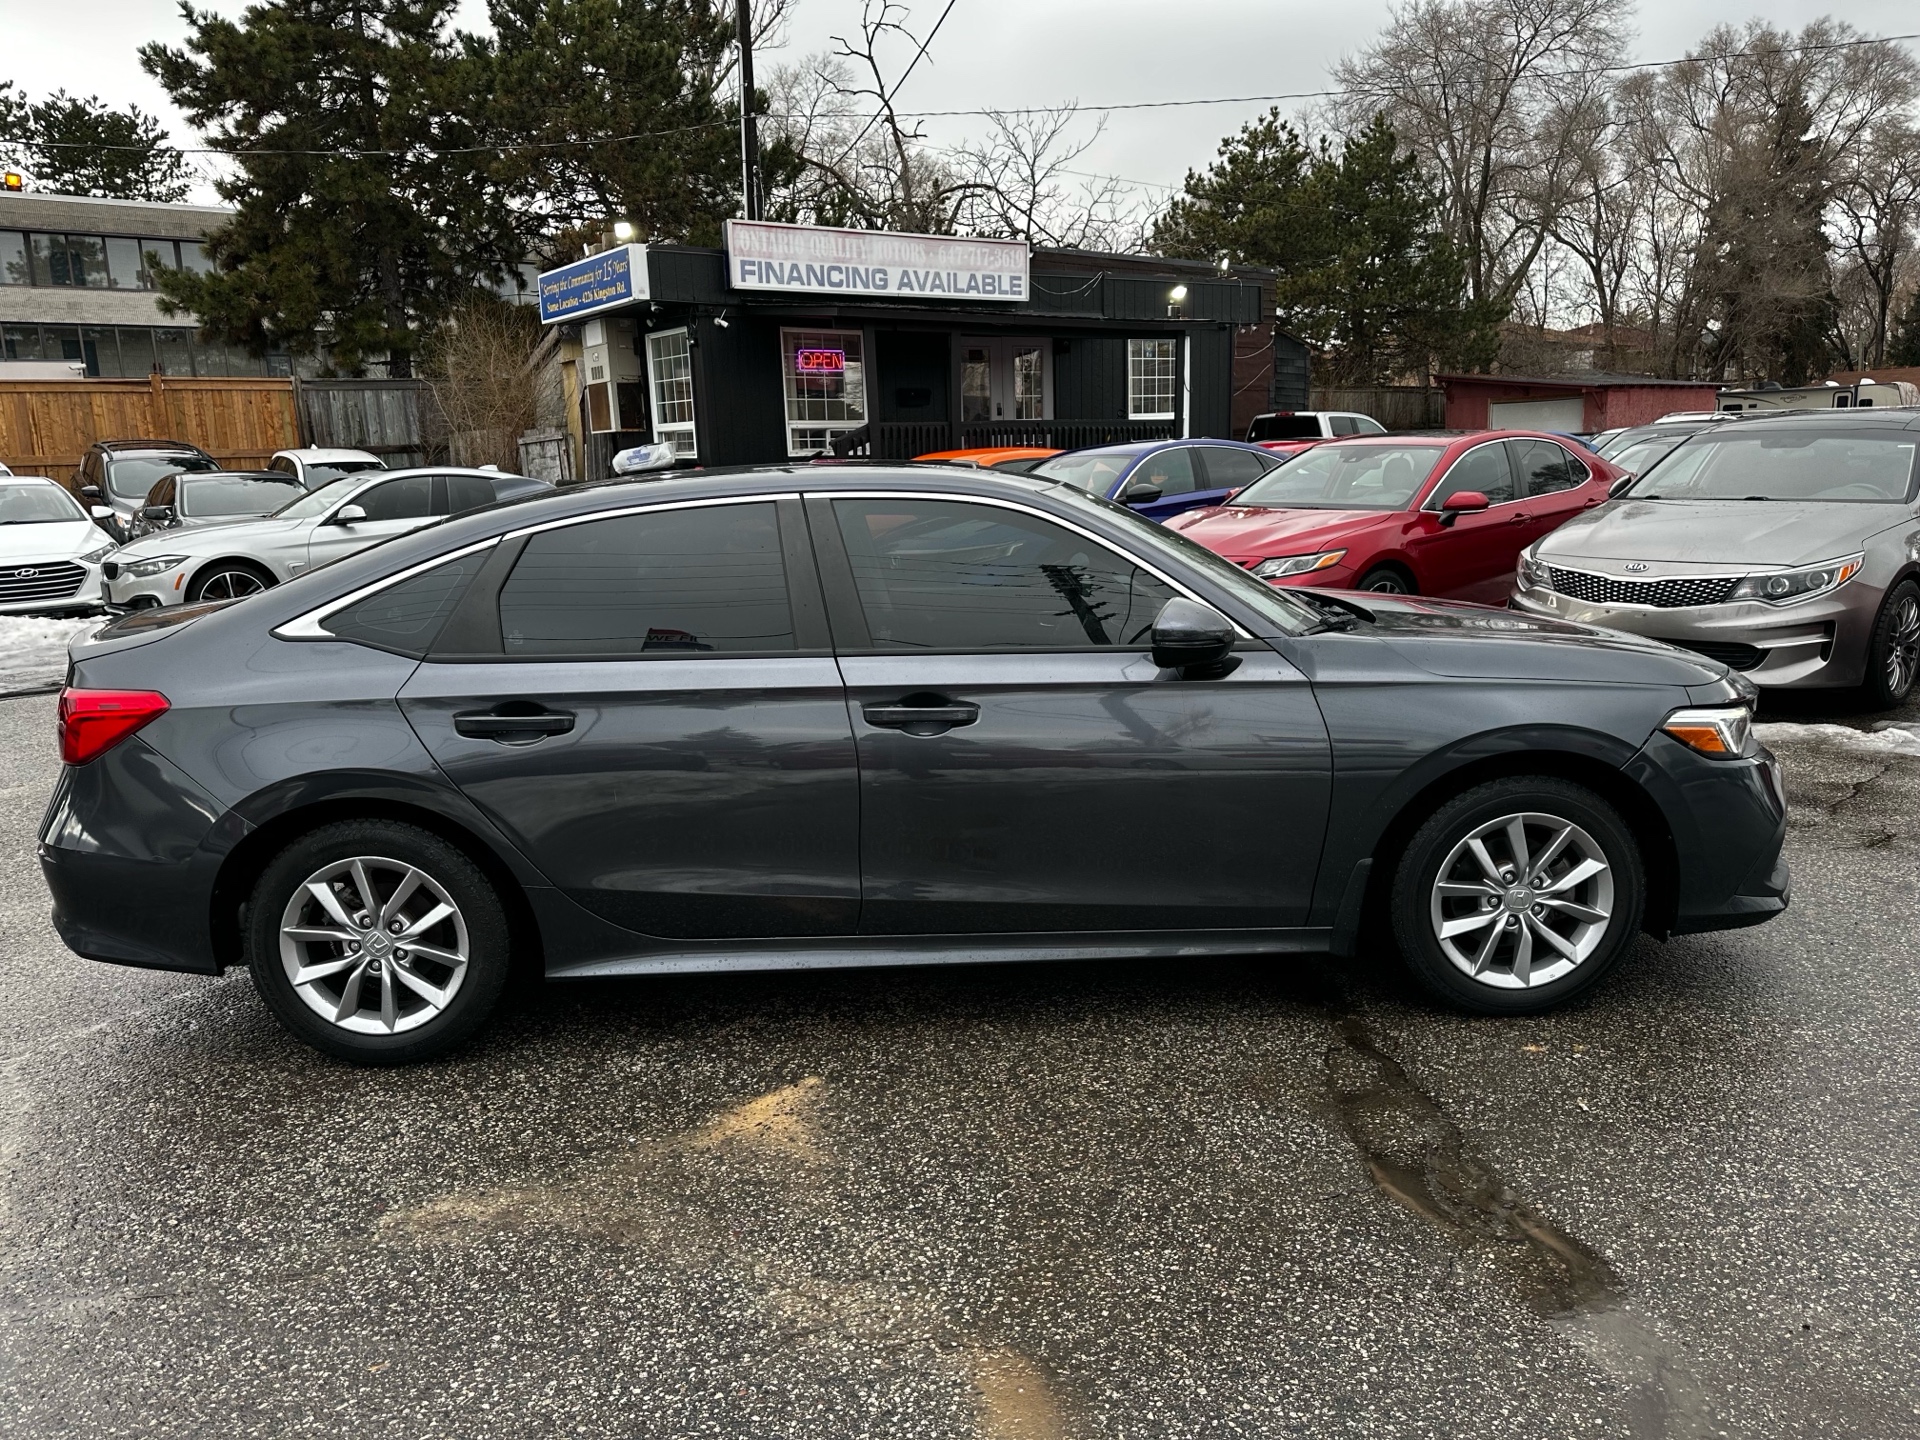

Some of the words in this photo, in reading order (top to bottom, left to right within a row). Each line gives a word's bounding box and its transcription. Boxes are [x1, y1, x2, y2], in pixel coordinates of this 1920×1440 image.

[740, 229, 804, 255] ONTARIO
[810, 234, 868, 259] QUALITY
[740, 259, 888, 290] FINANCING
[897, 269, 1022, 296] AVAILABLE
[593, 285, 616, 301] Kingston
[801, 352, 842, 369] OPEN
[648, 634, 675, 642] WE
